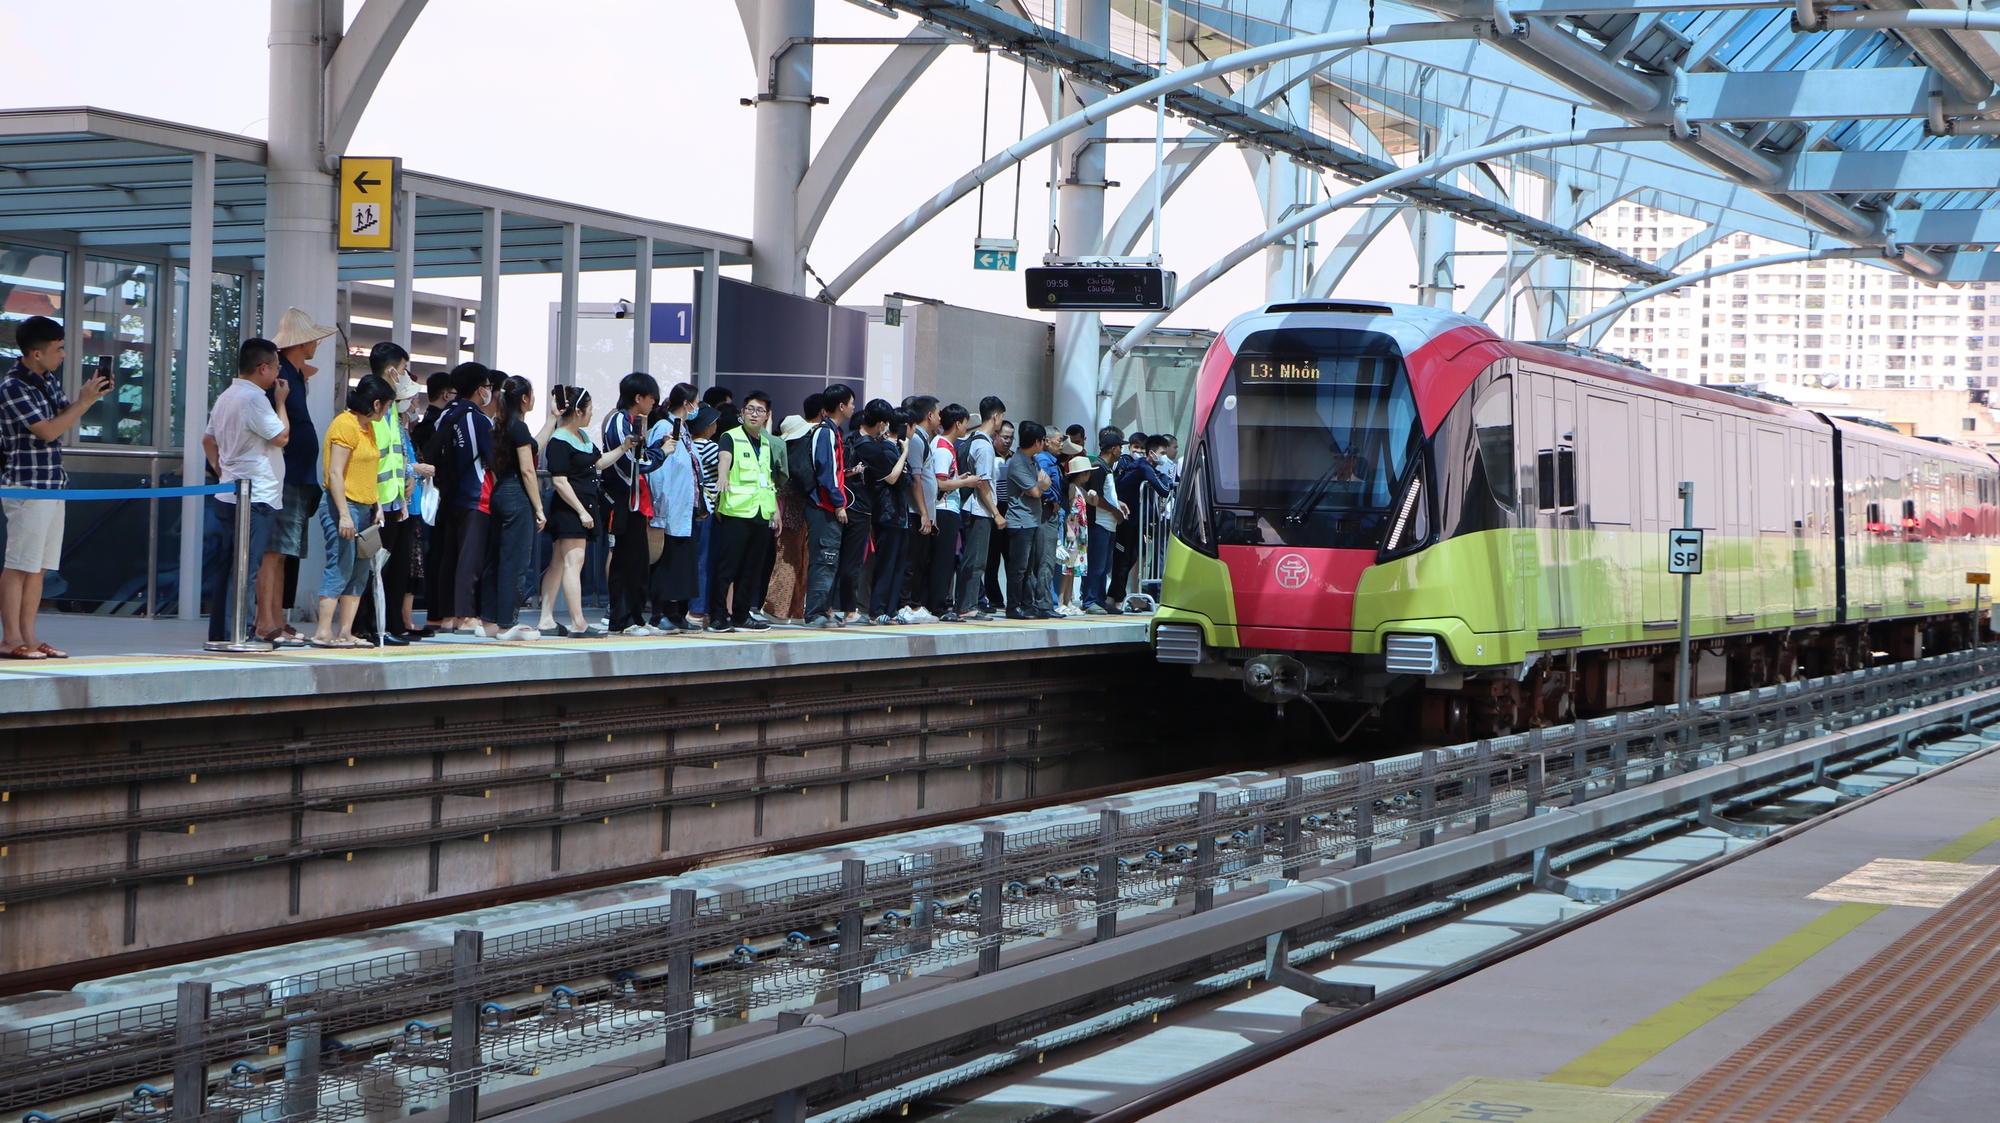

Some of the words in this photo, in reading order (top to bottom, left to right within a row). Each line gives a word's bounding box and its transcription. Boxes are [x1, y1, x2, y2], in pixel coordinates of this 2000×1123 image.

[1046, 280, 1069, 288] 09:58
[677, 310, 686, 336] 1
[1250, 363, 1273, 378] L3:
[1674, 552, 1698, 566] SP
